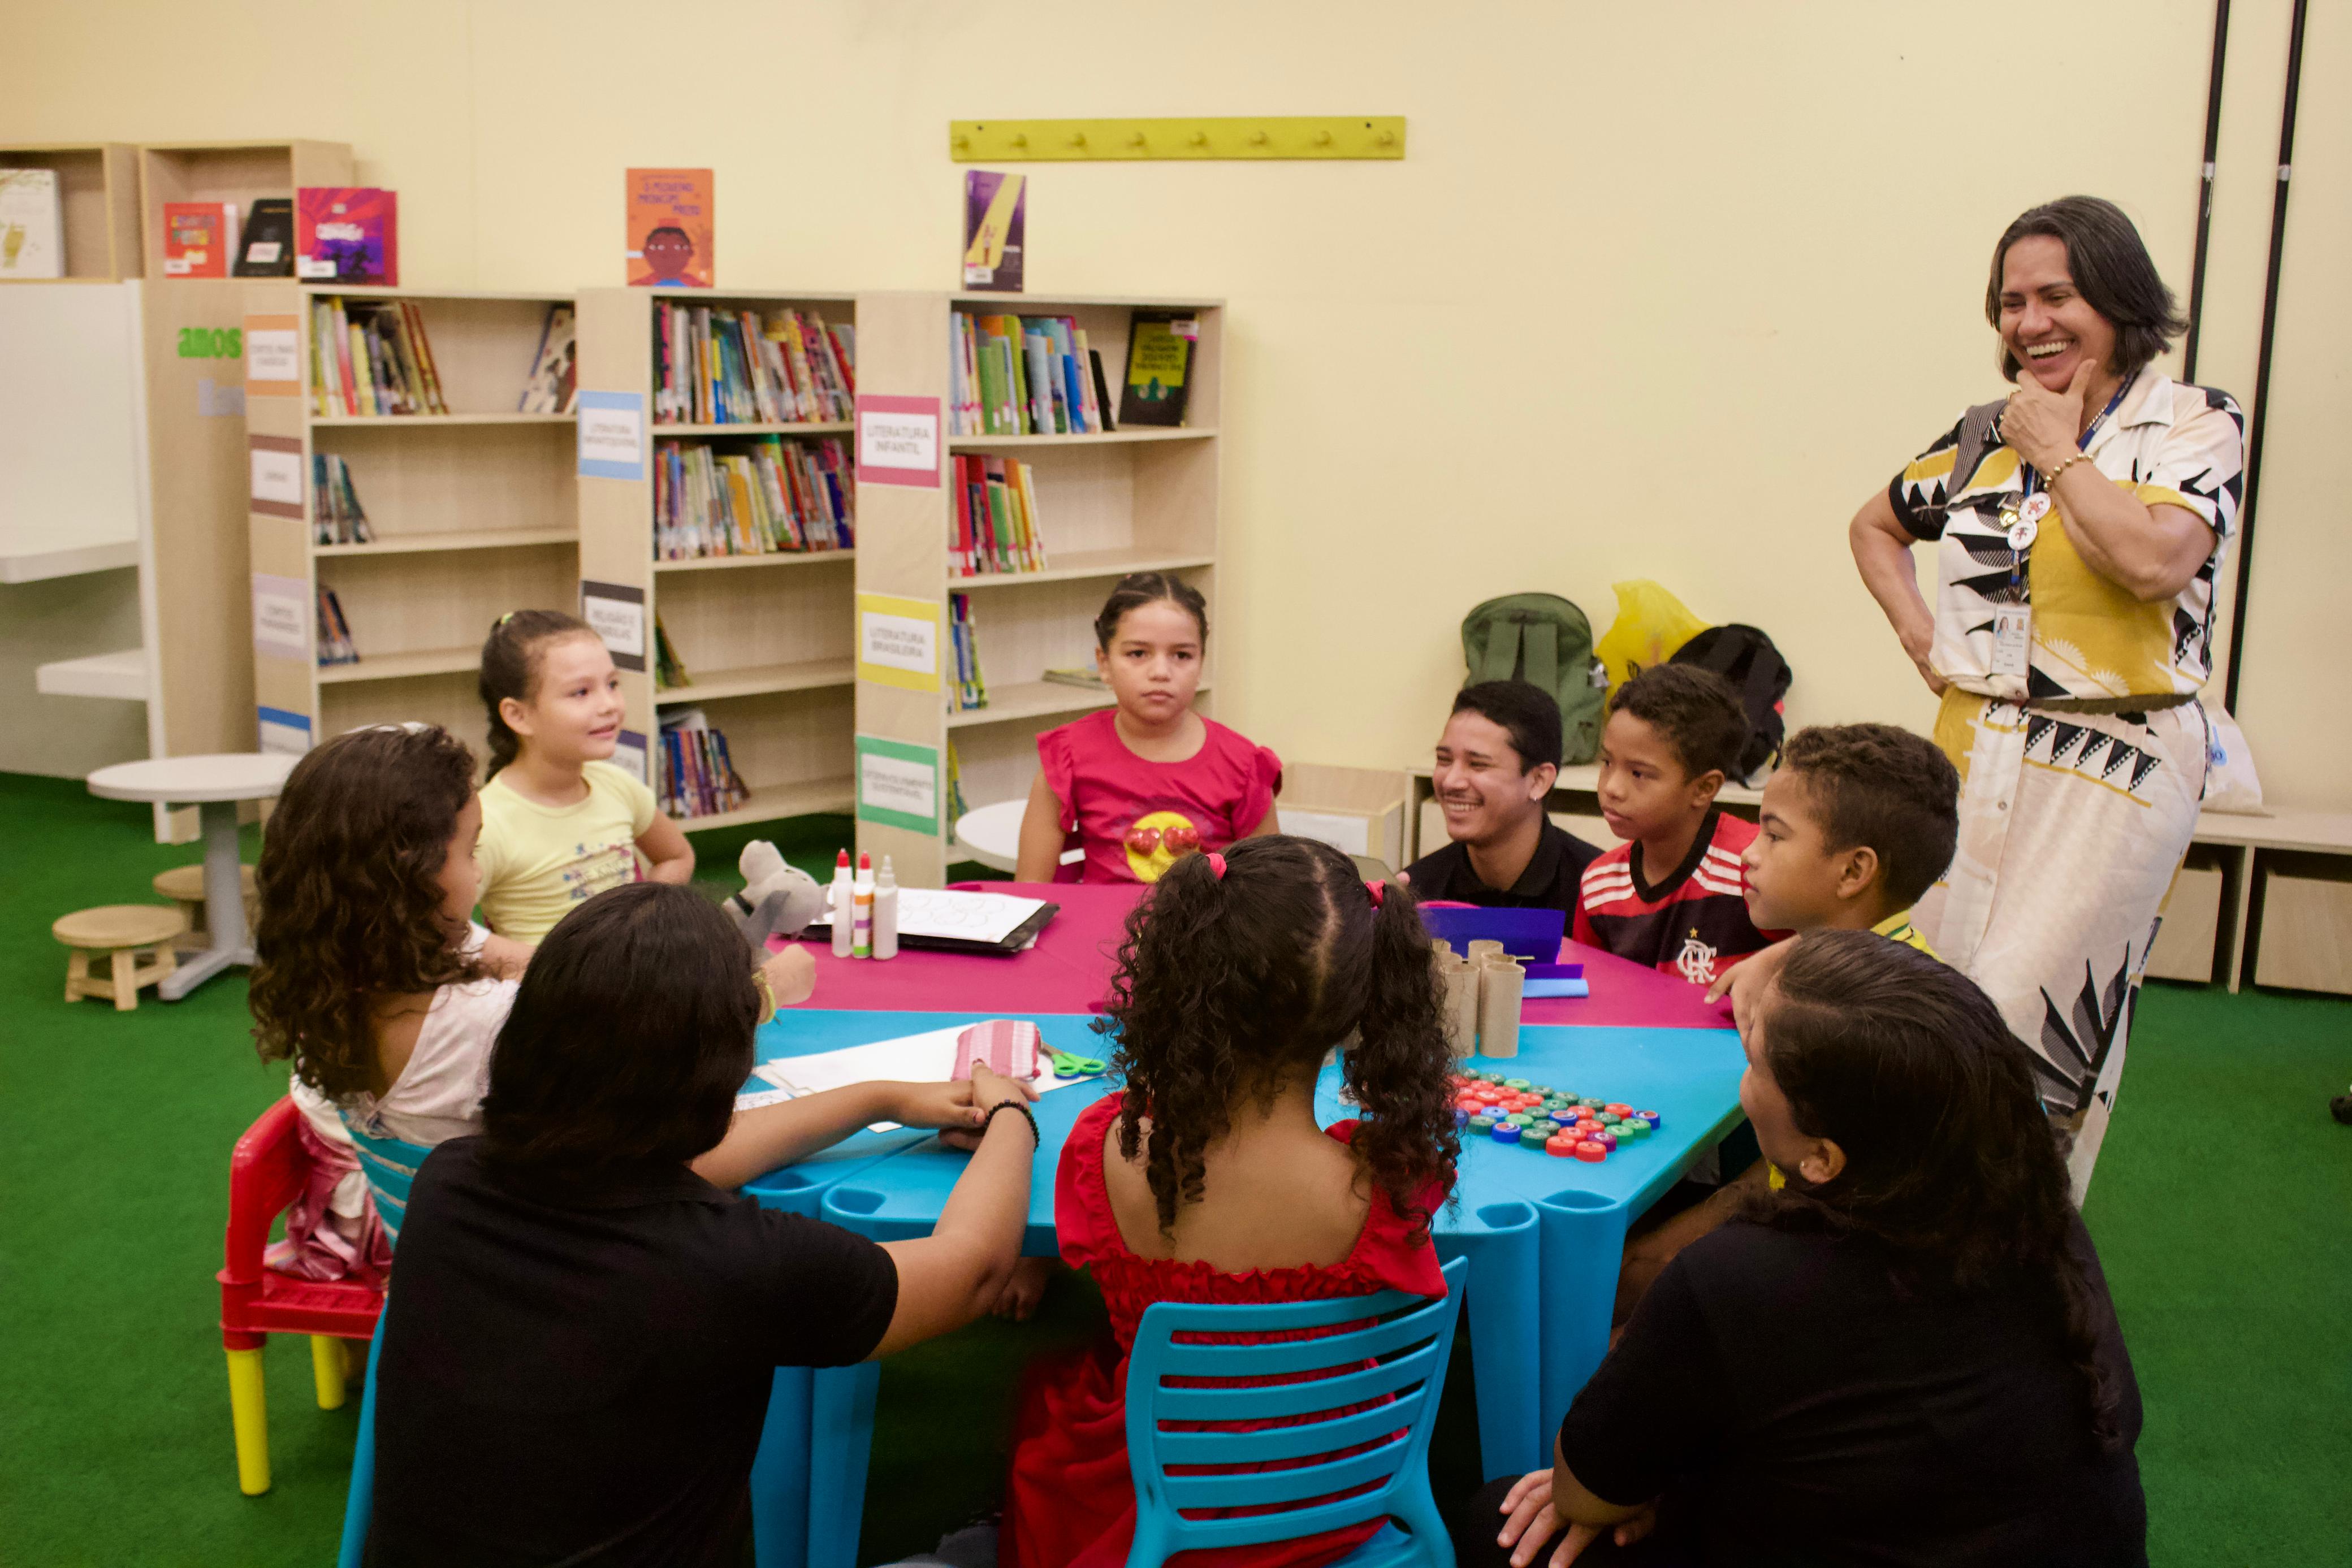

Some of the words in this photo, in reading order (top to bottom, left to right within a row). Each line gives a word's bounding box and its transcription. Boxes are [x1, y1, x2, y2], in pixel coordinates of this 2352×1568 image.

[866, 425, 931, 440] LITERATURA
[875, 440, 923, 456] INFANTIL
[869, 626, 927, 644] LITERATURA
[871, 640, 924, 658] BRASILEIRA
